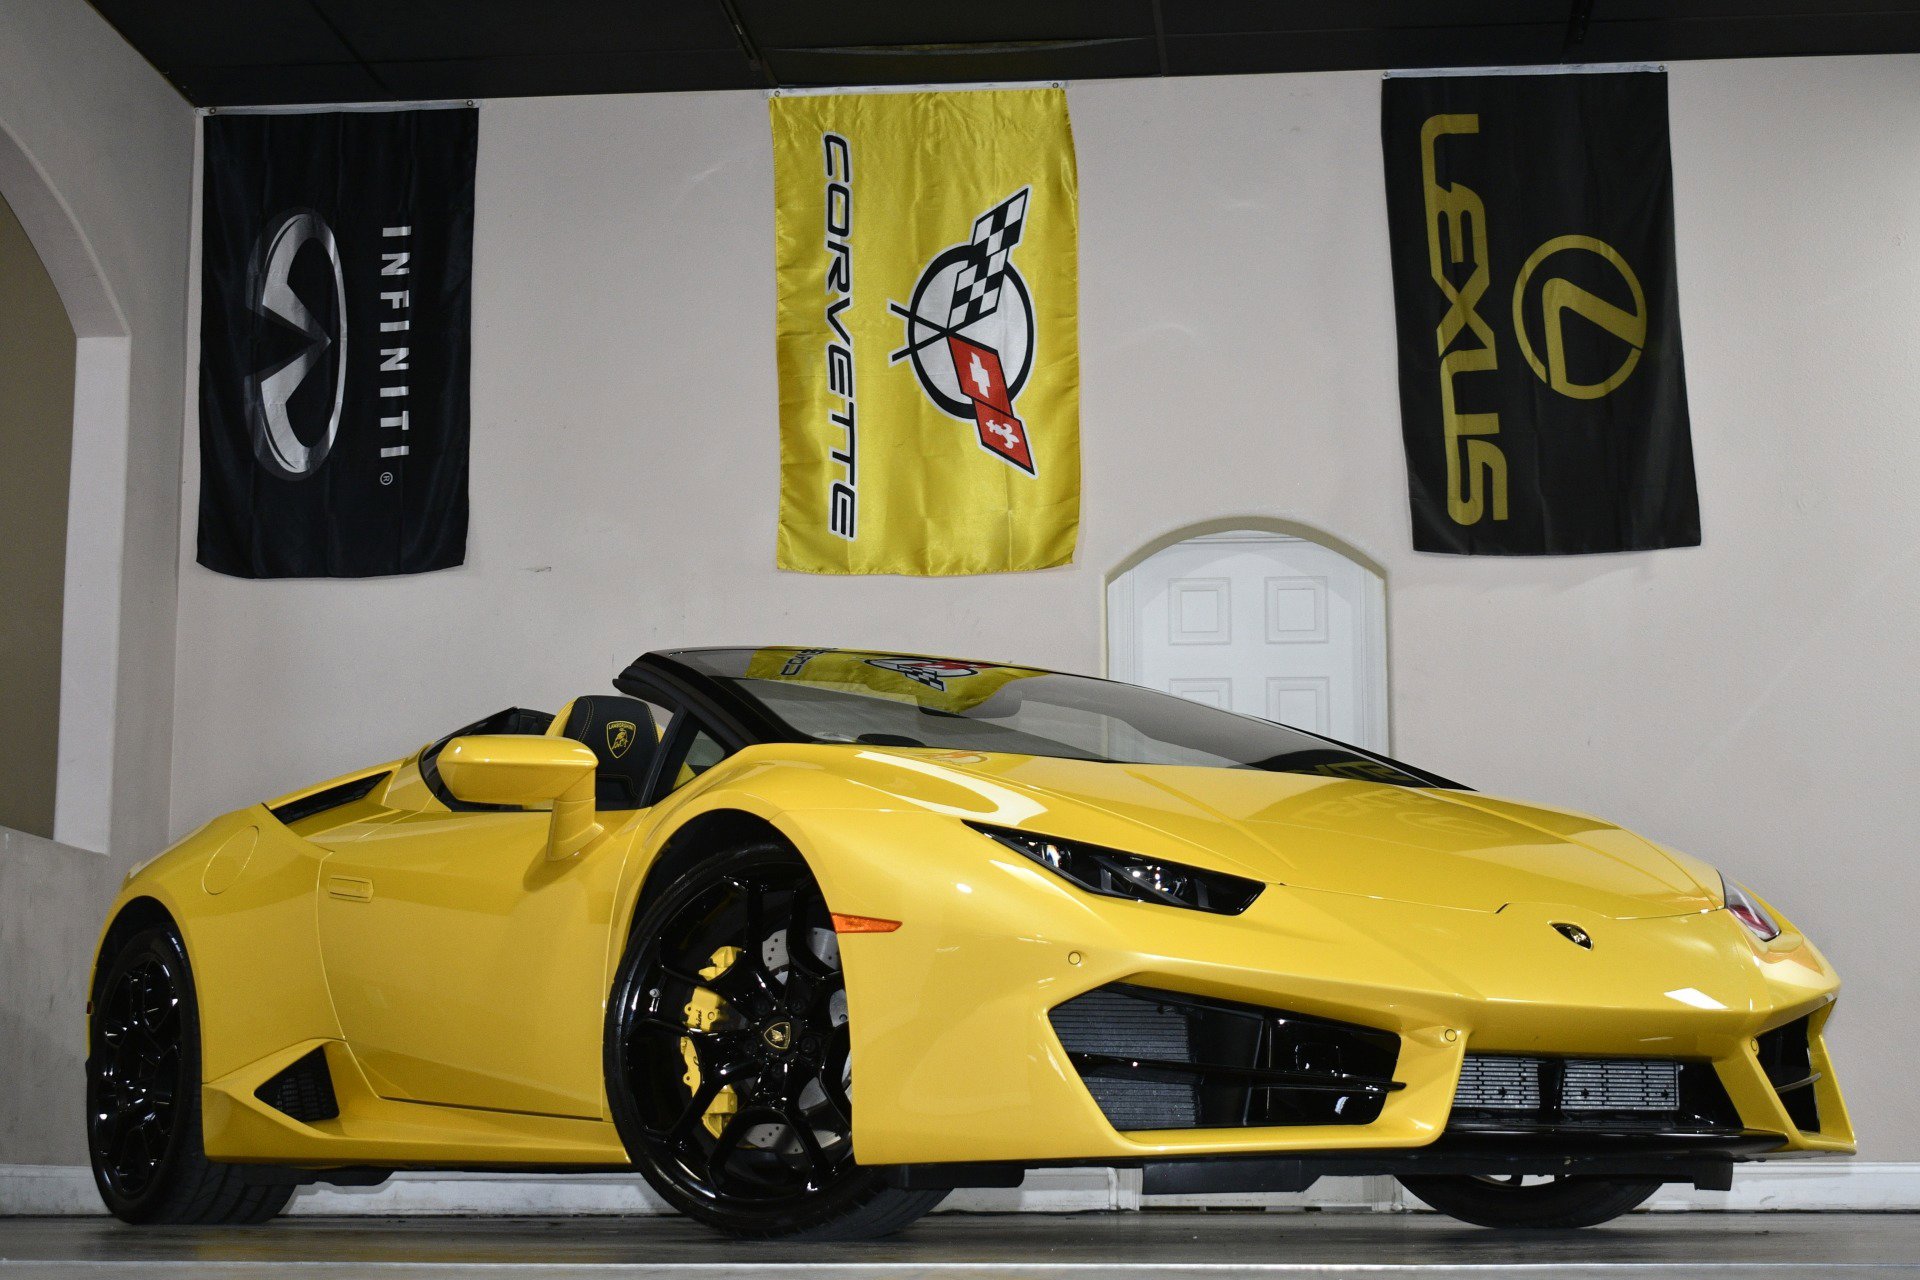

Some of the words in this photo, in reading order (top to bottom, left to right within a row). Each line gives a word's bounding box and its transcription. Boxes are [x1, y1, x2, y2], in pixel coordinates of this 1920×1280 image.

[380, 225, 411, 458] INFINITI
[824, 132, 857, 540] CORVETTE
[1420, 113, 1508, 526] LEXUS
